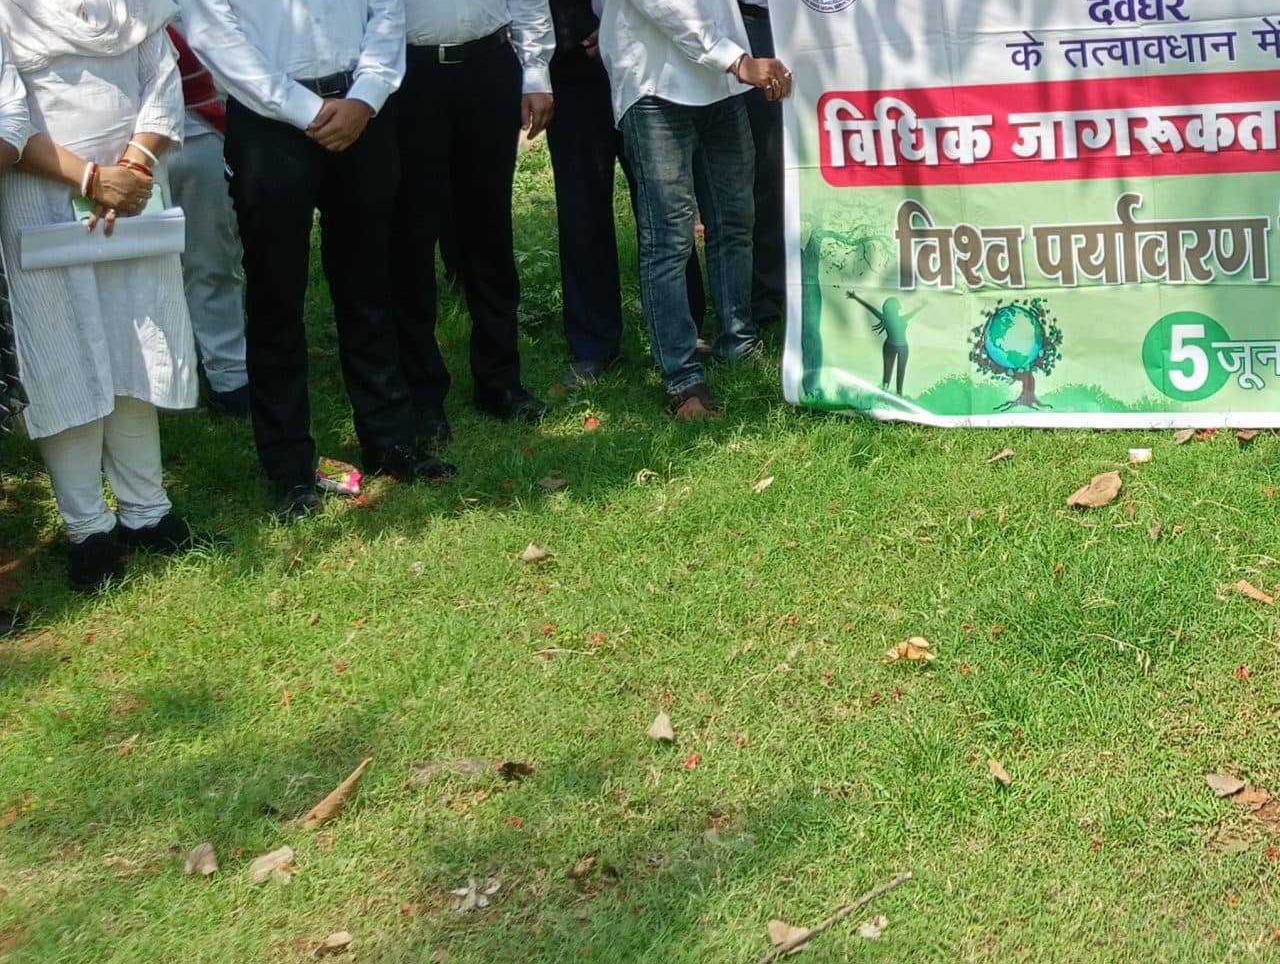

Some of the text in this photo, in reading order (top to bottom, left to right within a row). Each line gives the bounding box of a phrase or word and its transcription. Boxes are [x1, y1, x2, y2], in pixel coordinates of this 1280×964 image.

[1006, 30, 1044, 71] के
[1059, 31, 1237, 69] तत्वावधान
[823, 97, 993, 167] विधिक
[894, 199, 1024, 290] विश्व
[1031, 192, 1270, 286] पर्यावरण
[1168, 324, 1209, 392] 5
